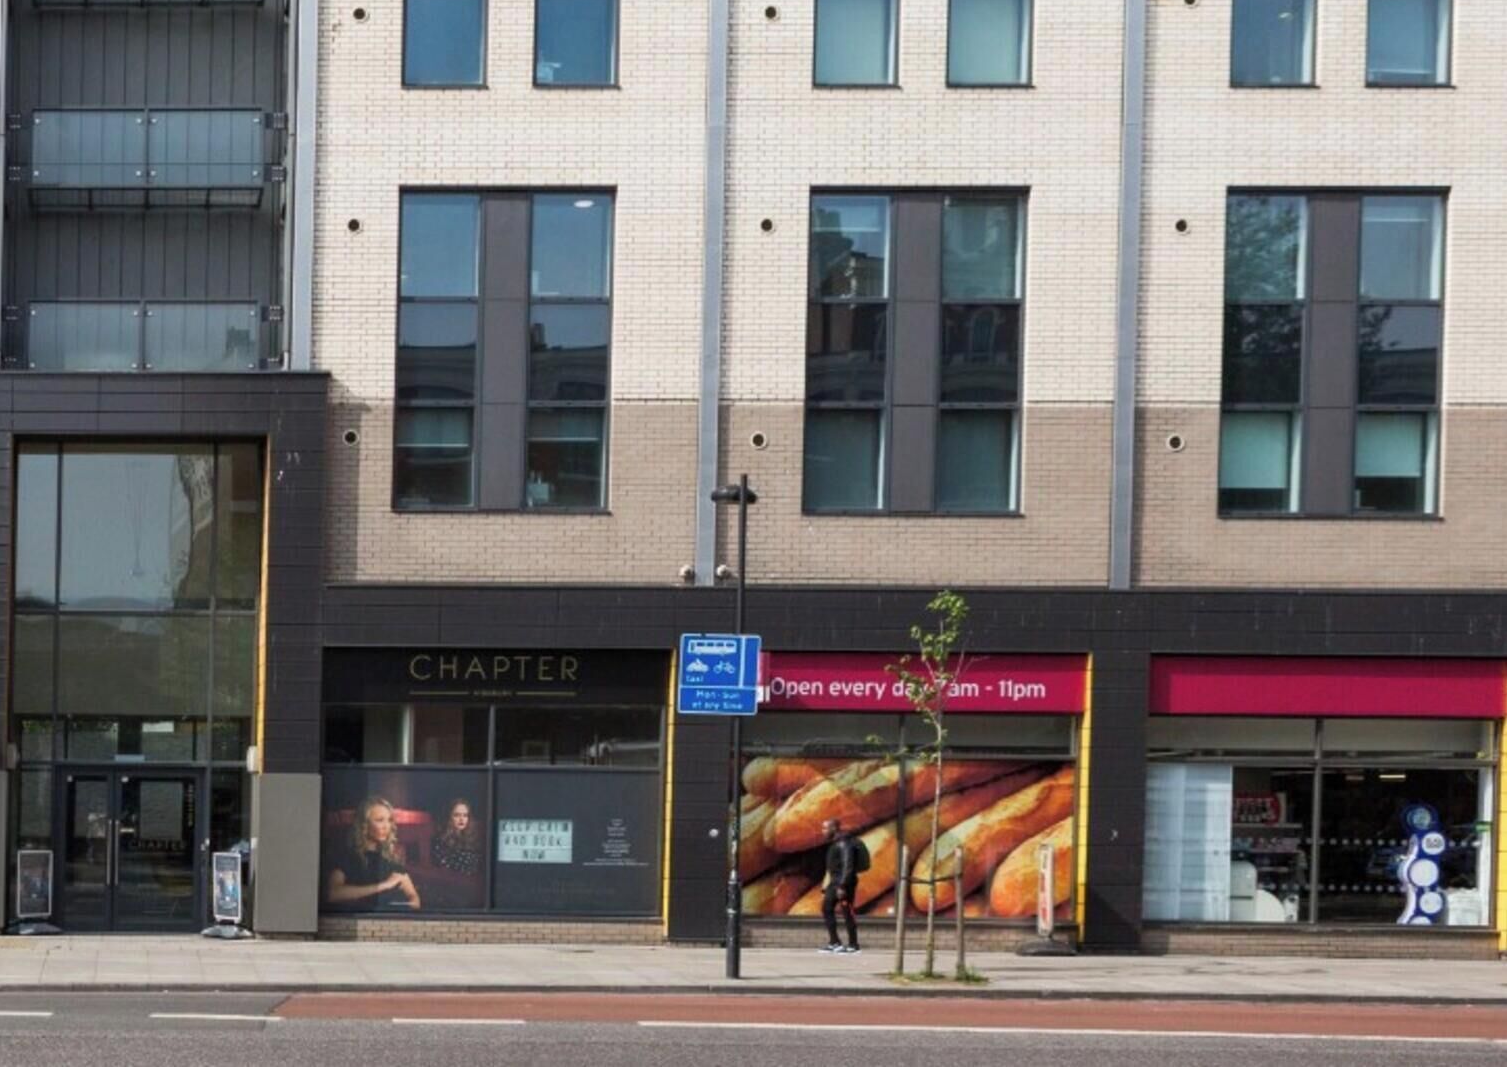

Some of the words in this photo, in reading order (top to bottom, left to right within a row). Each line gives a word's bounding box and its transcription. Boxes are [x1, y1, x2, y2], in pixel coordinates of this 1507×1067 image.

[409, 654, 579, 681] CHAPTER
[771, 677, 824, 699] Open
[829, 681, 887, 700] every
[998, 679, 1046, 701] 11pm
